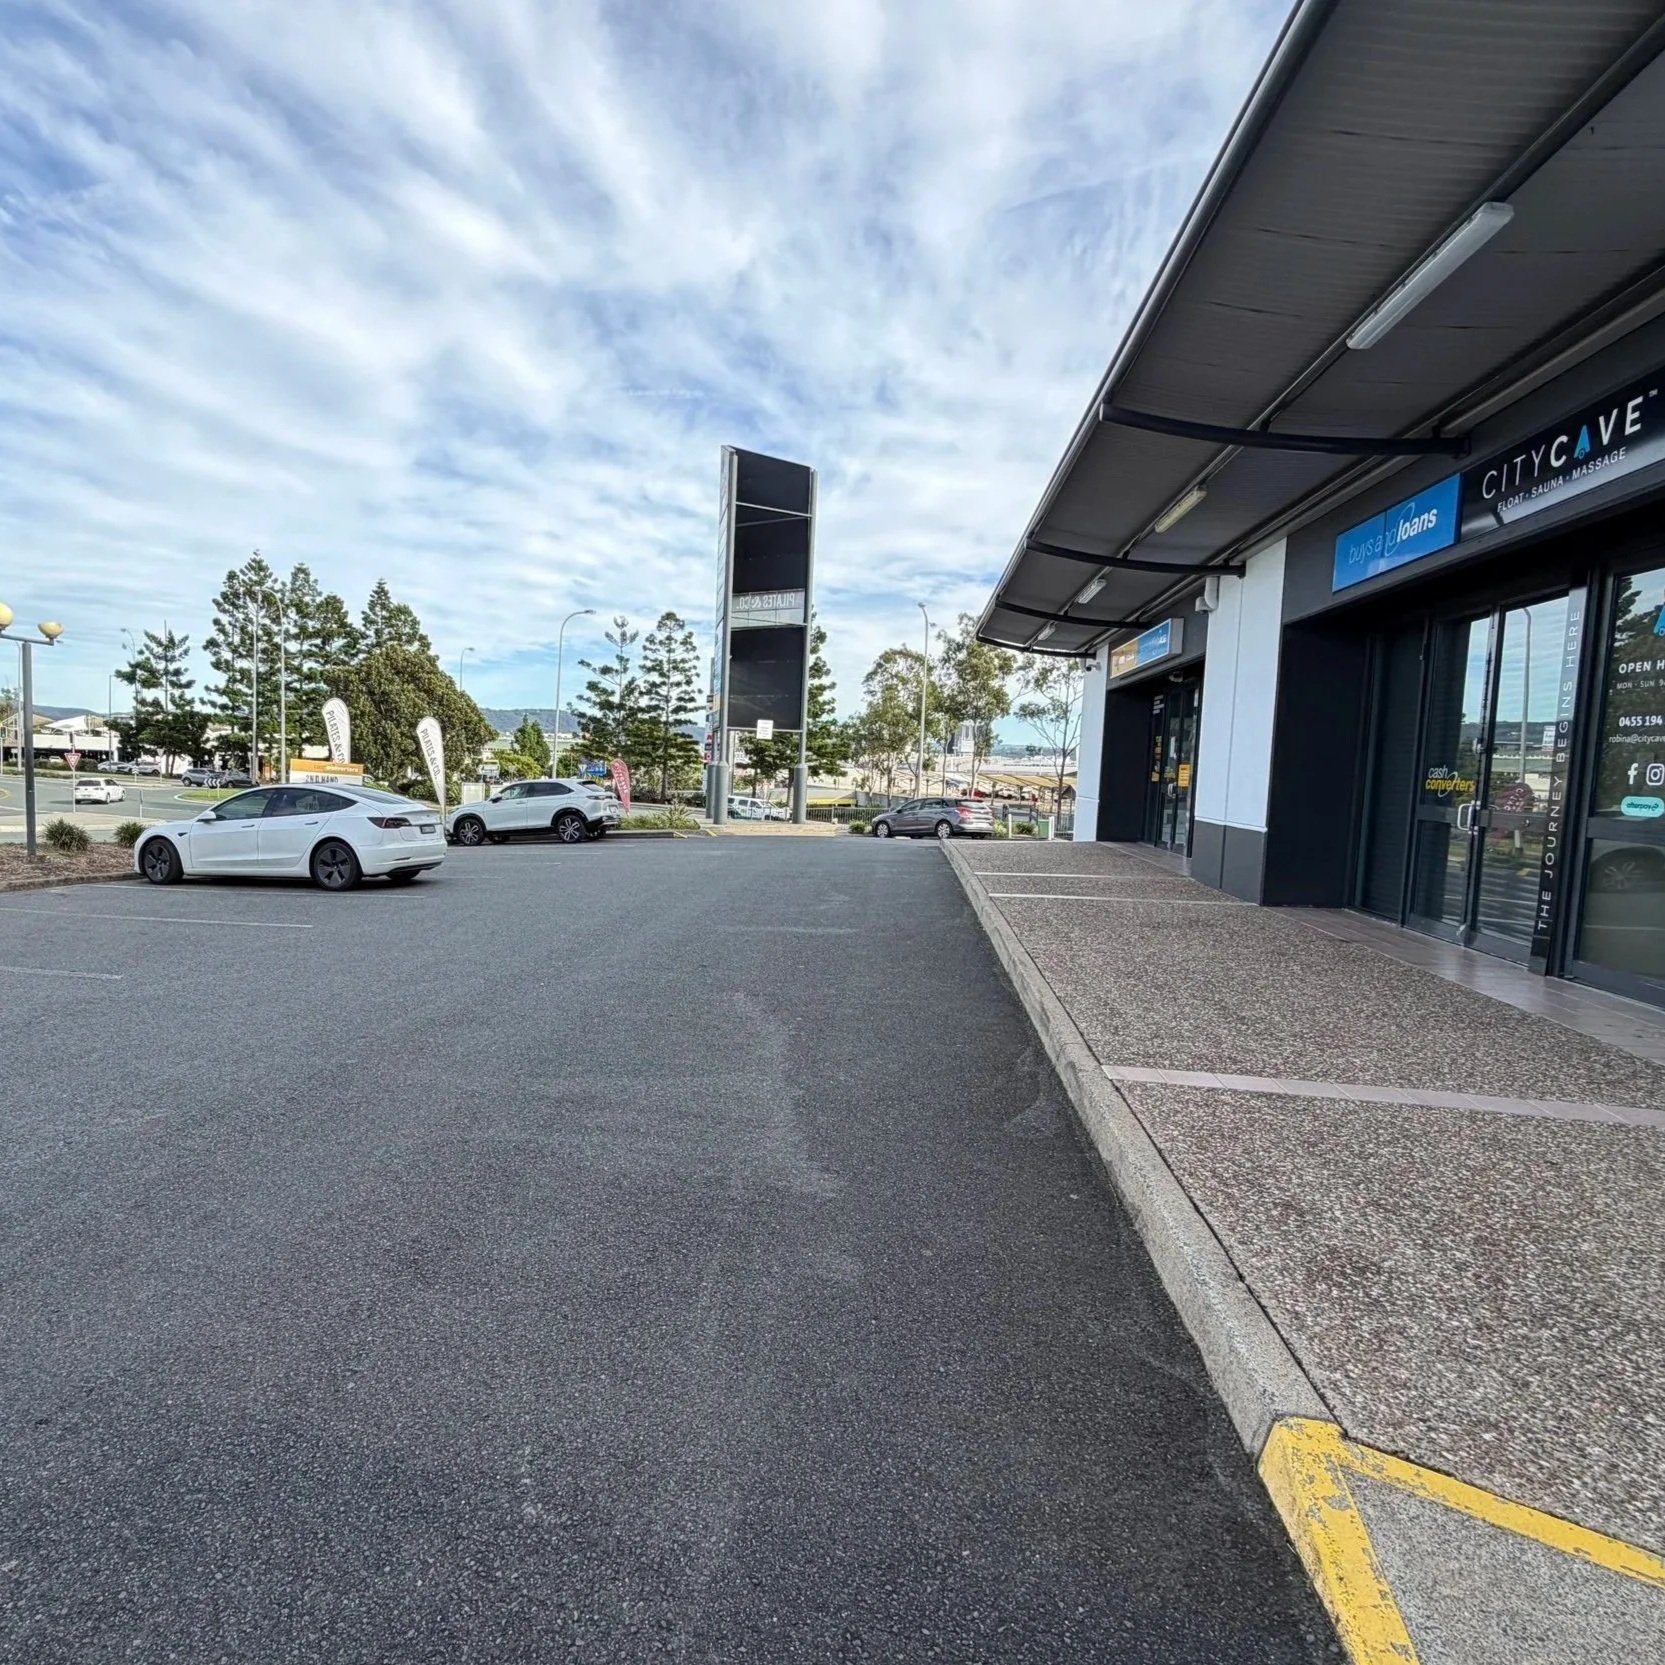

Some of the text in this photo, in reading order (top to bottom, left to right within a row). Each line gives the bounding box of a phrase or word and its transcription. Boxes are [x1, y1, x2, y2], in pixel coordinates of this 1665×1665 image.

[1497, 447, 1627, 512] FLOAT SAUNA MASSAGE
[1618, 661, 1652, 674] OPEN
[1640, 680, 1655, 688] SUN
[326, 711, 341, 743] PILATES
[1618, 715, 1663, 727] 0455 194
[420, 728, 435, 757] PILATES
[1428, 765, 1448, 778] cash
[1537, 610, 1580, 930] THE JOURNEY BEGINS HERE
[1425, 778, 1475, 792] converters
